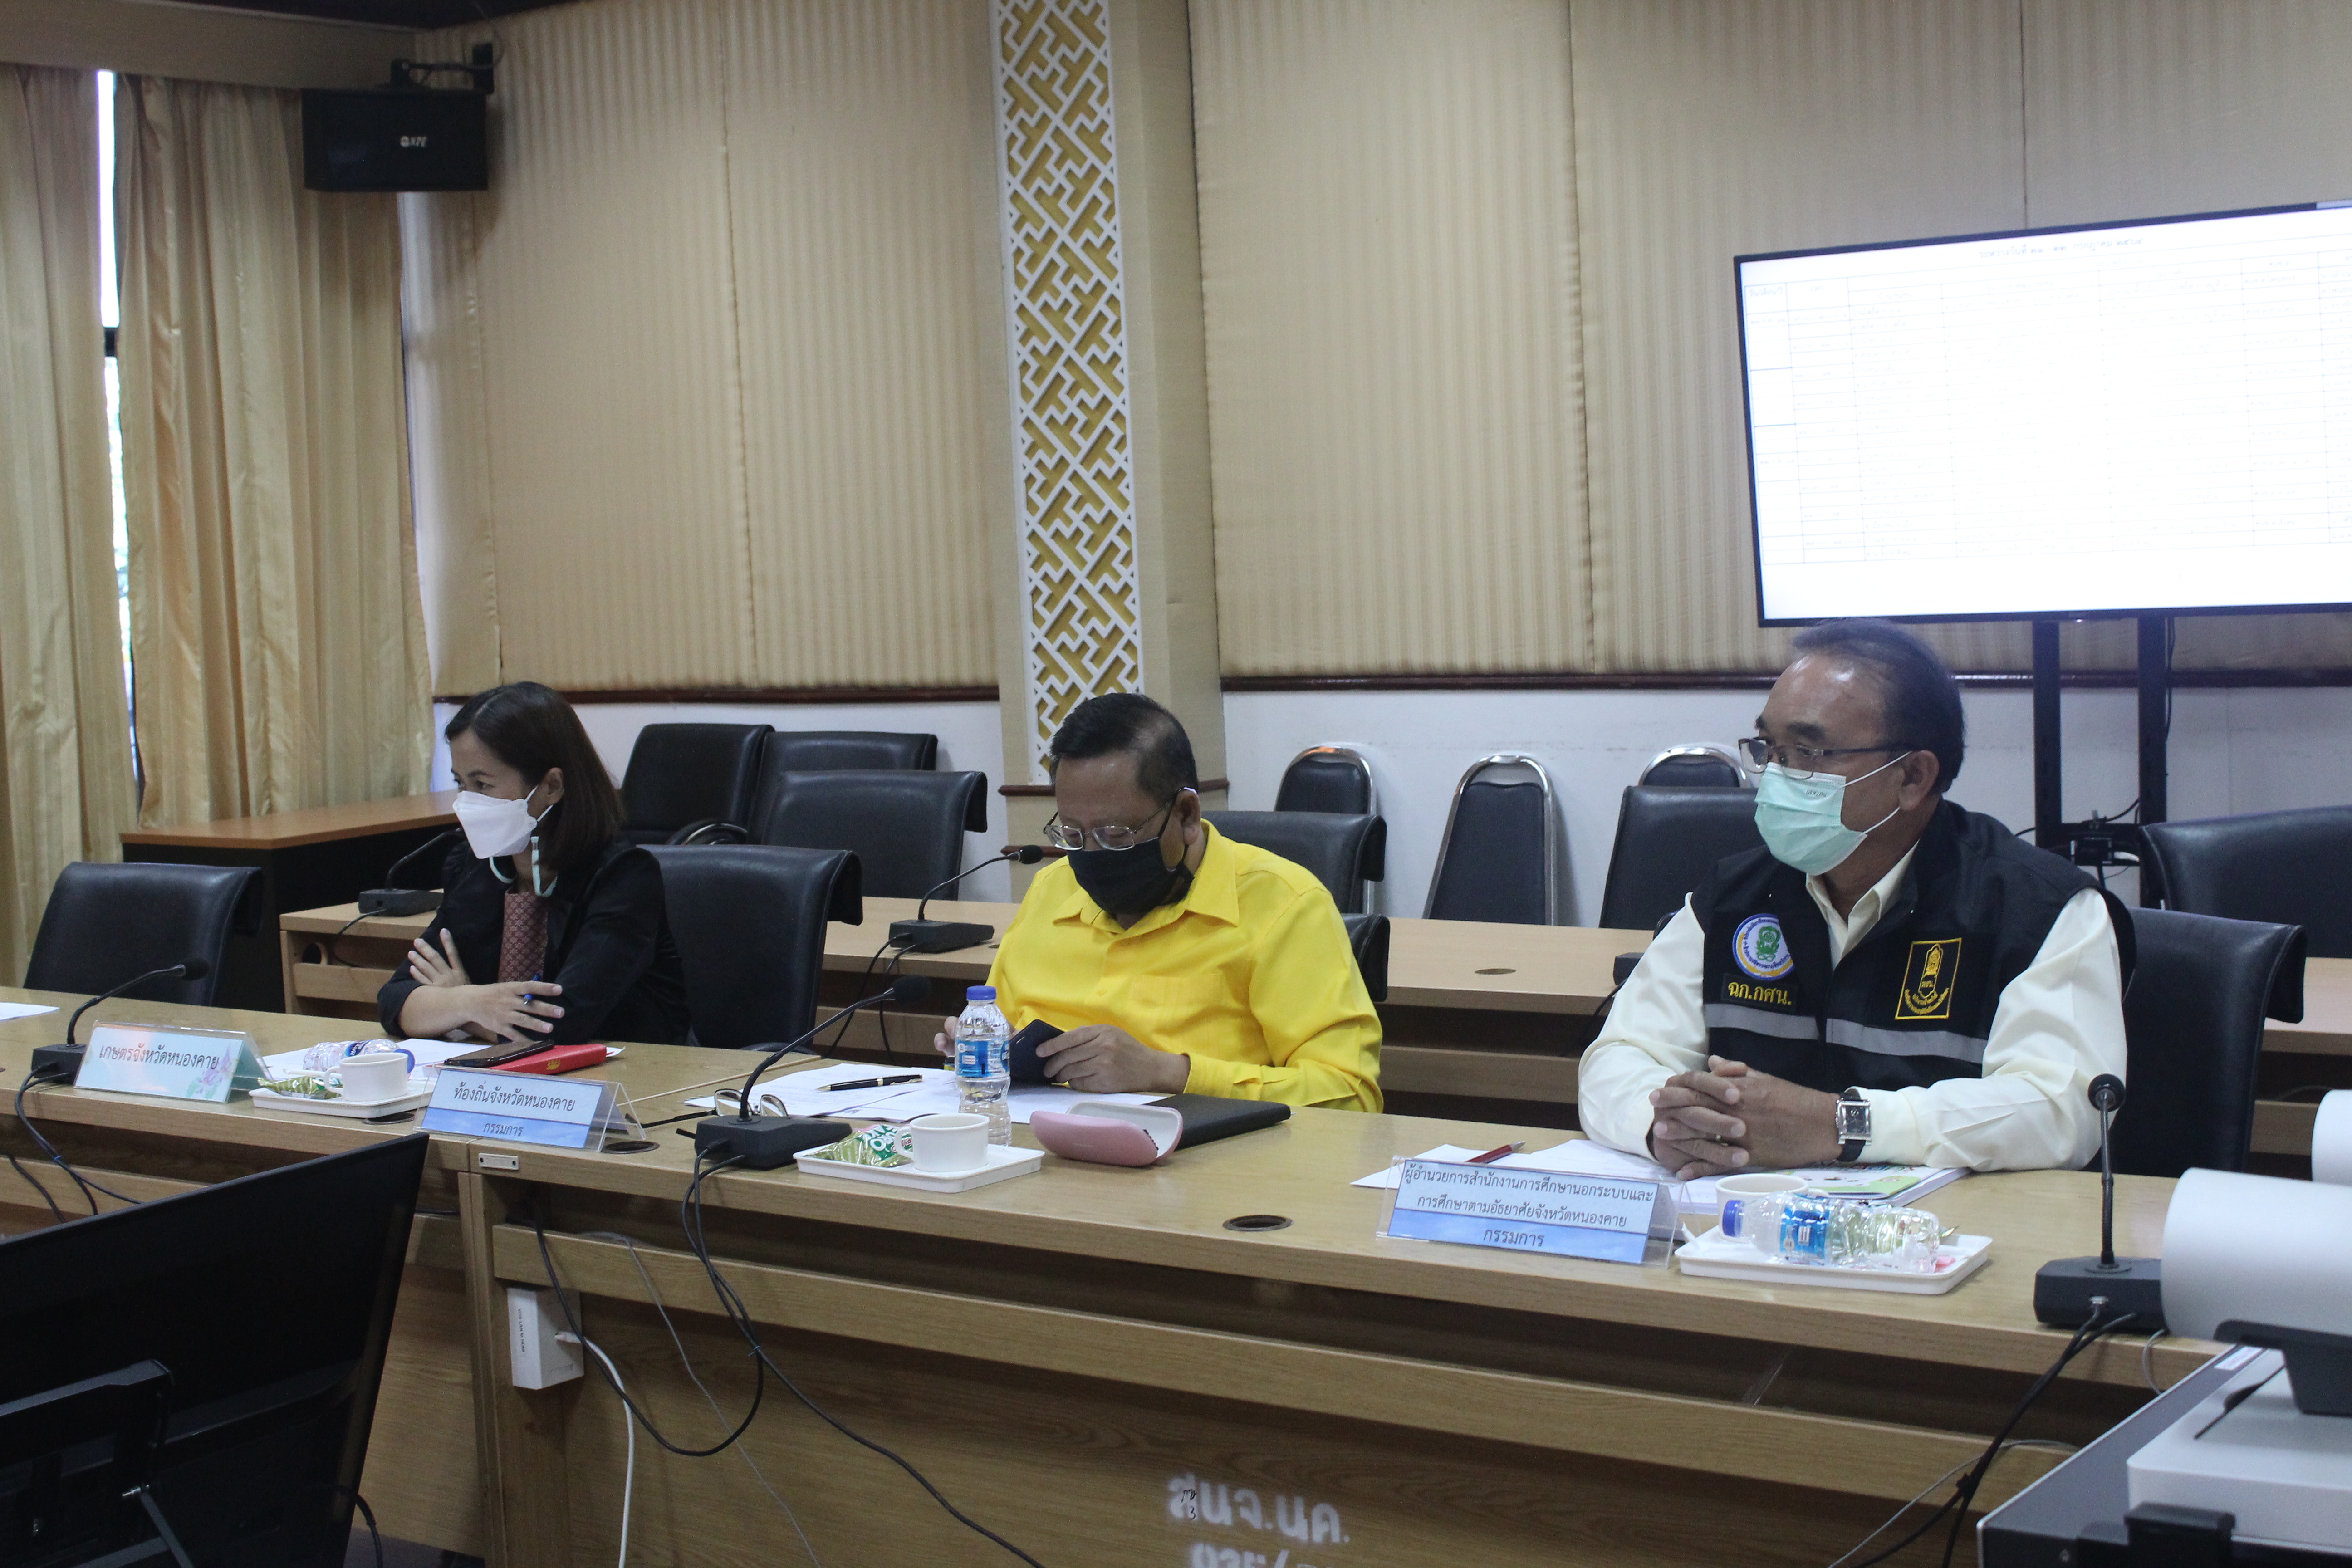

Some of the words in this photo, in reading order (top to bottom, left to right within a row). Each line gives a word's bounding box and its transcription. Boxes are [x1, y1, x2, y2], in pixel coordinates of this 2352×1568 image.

[1728, 982, 1792, 1005] ฉก.กศน.
[99, 1043, 220, 1069] เกษตรจังหวัดหนองคาย
[454, 1081, 576, 1112] ท้องถิ่นจังหวัดหนองคาย
[483, 1123, 524, 1137] กรรมการ
[1405, 1163, 1653, 1201] ผู้อำนวยการสำนักงานการศึกษานอกระบบและ
[1417, 1194, 1627, 1227] การศึกษาตามอัธยาศัยจังหวัดหนองคาย
[1482, 1227, 1545, 1247] กรรมการ
